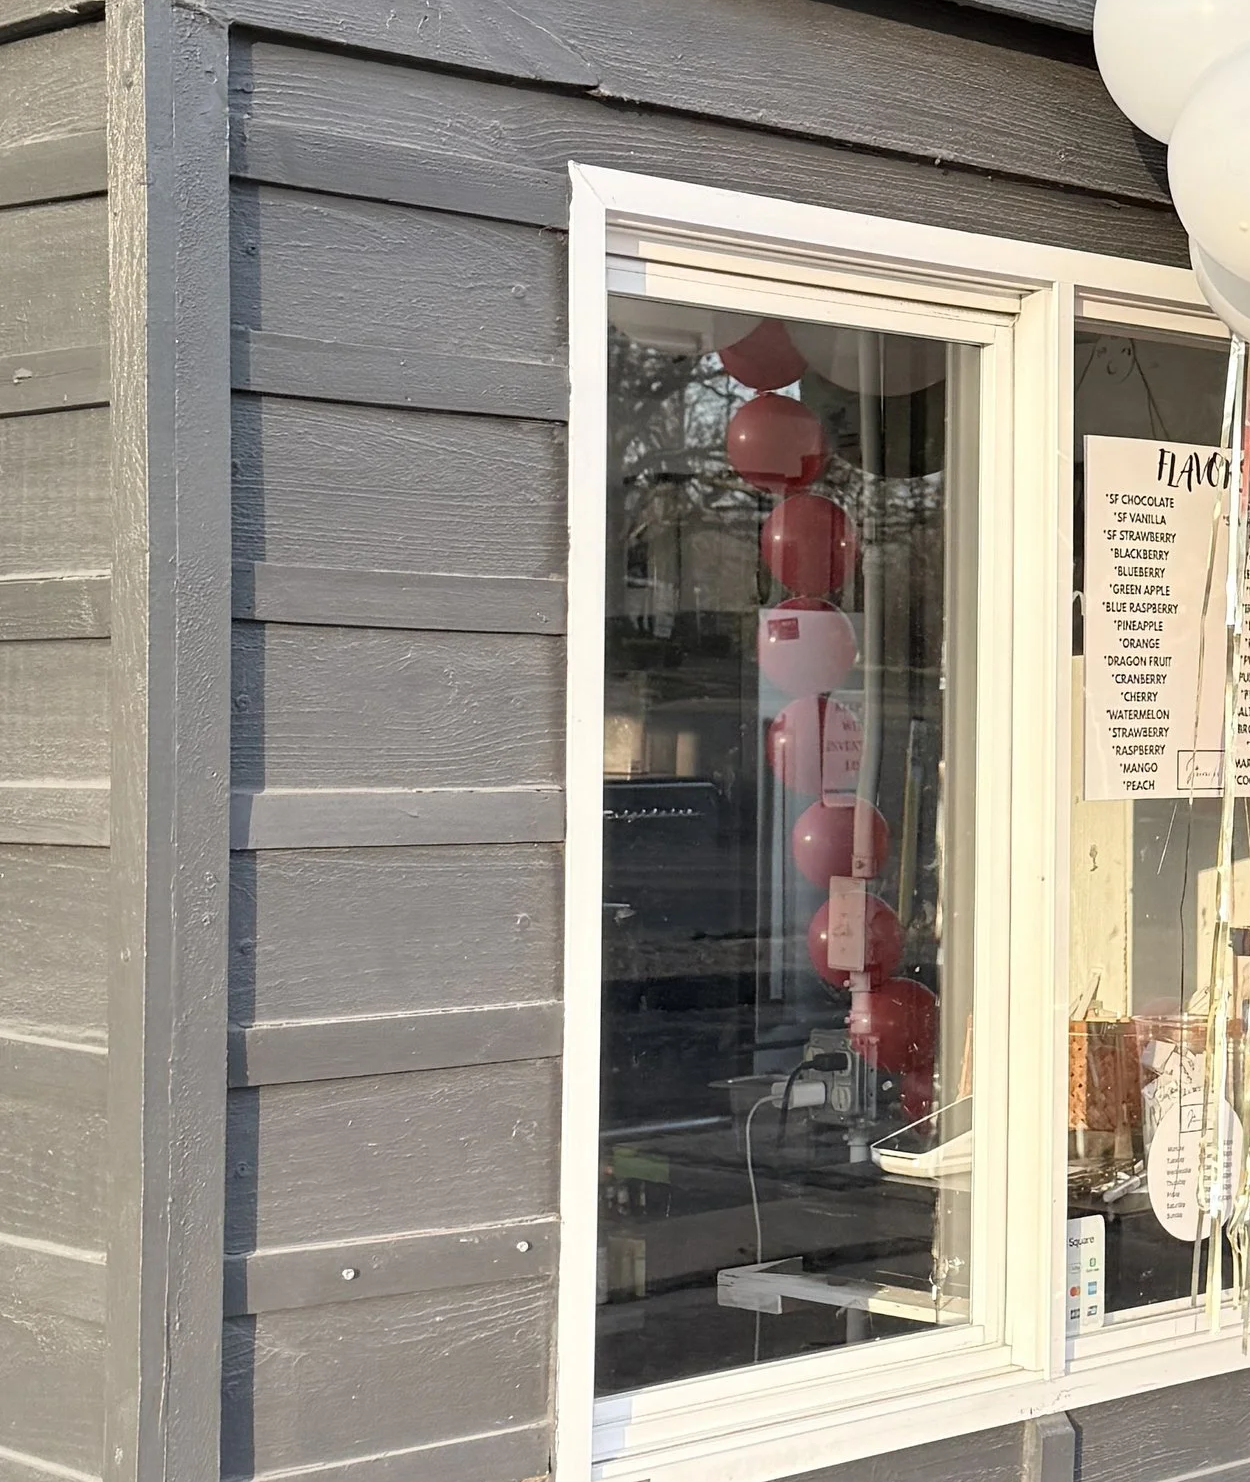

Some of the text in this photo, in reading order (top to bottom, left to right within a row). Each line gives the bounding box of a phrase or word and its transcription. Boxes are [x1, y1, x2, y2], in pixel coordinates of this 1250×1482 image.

[1109, 493, 1175, 508] SF CHOCOLATE
[1117, 512, 1167, 525] SF VANILLA
[1107, 530, 1176, 543] SF STRAWBERRY
[1114, 548, 1169, 560] BLACKBERRY
[1117, 566, 1165, 578] BLUEBERRY
[1112, 584, 1171, 596] GREEN APPLE
[1105, 602, 1178, 614] BLUE RASPBERRY
[1117, 620, 1163, 631] PINEAPPLE
[1122, 638, 1160, 649] ORANGE
[1107, 656, 1172, 667] DRAGON FRUIT
[1115, 673, 1167, 684] CRANBERRY
[1124, 691, 1158, 702] CHERRY
[1109, 709, 1170, 720] WATERMELON
[1112, 727, 1169, 738] STRAWBERRY
[1116, 745, 1165, 756] RASPBERRY
[1123, 762, 1158, 773] MANGO
[1126, 780, 1155, 791] PEACH
[1068, 1236, 1095, 1248] Square
